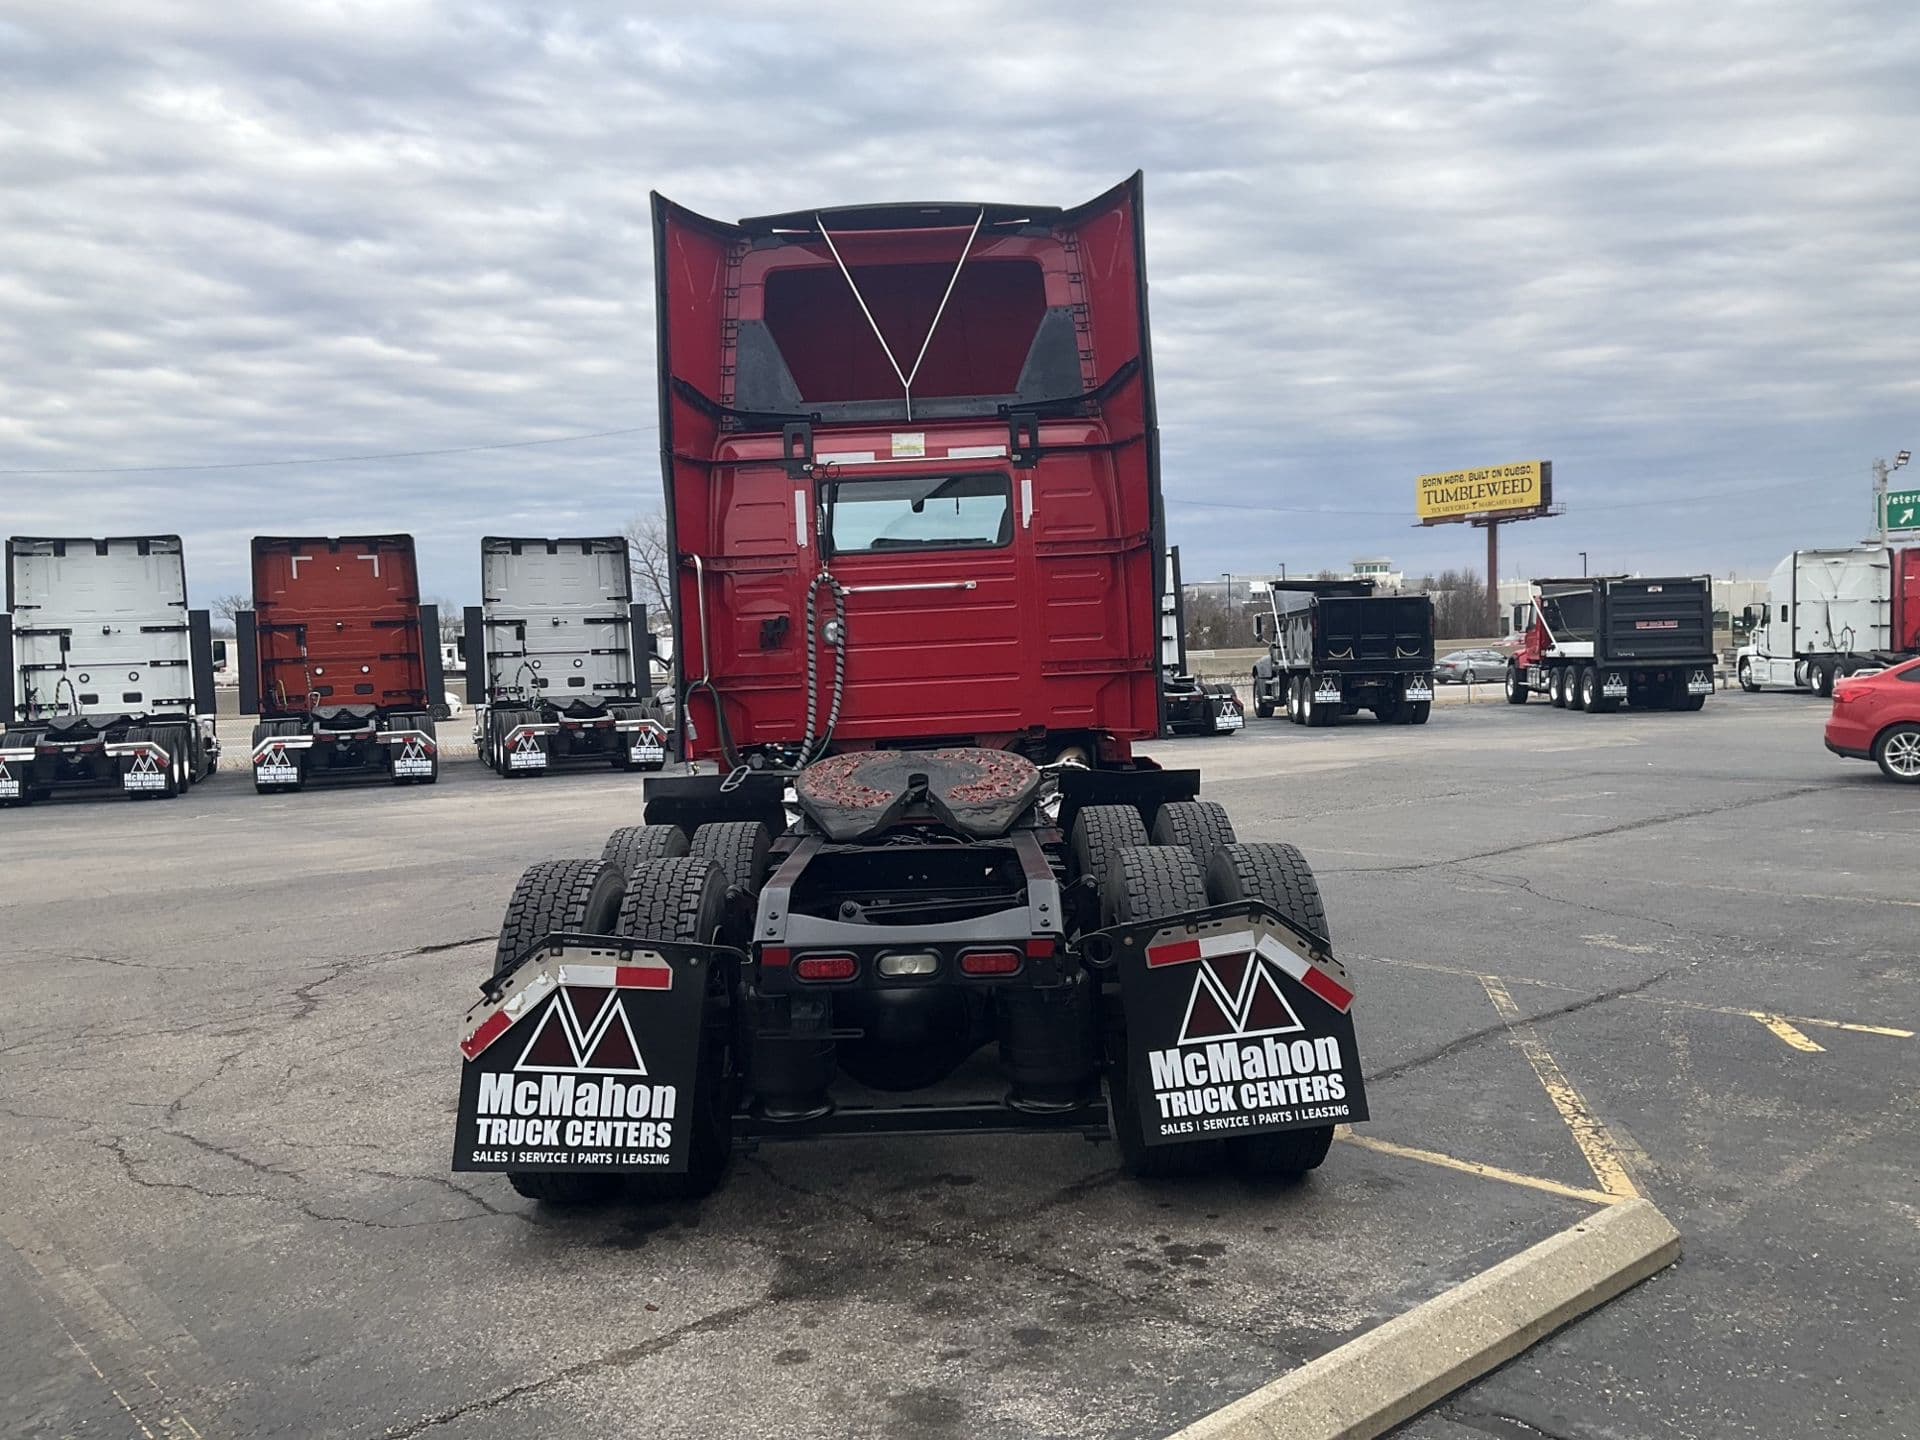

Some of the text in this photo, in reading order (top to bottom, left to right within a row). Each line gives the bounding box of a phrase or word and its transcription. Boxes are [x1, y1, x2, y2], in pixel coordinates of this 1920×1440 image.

[1423, 477, 1443, 488] BORN
[1469, 470, 1489, 481] BUILT
[1492, 469, 1503, 478] ON
[1424, 477, 1533, 505] TUMBLEWEED
[1149, 1035, 1342, 1090] McMahon
[477, 1072, 677, 1119] McMahon
[1155, 1073, 1346, 1118] TRUCK CENTERS
[476, 1118, 672, 1148] TRUCK CENTERS
[1160, 1104, 1349, 1135] SALES SERVICE PARTS LEASING
[472, 1150, 670, 1165] SALES SERVICE PARTS LEASING
